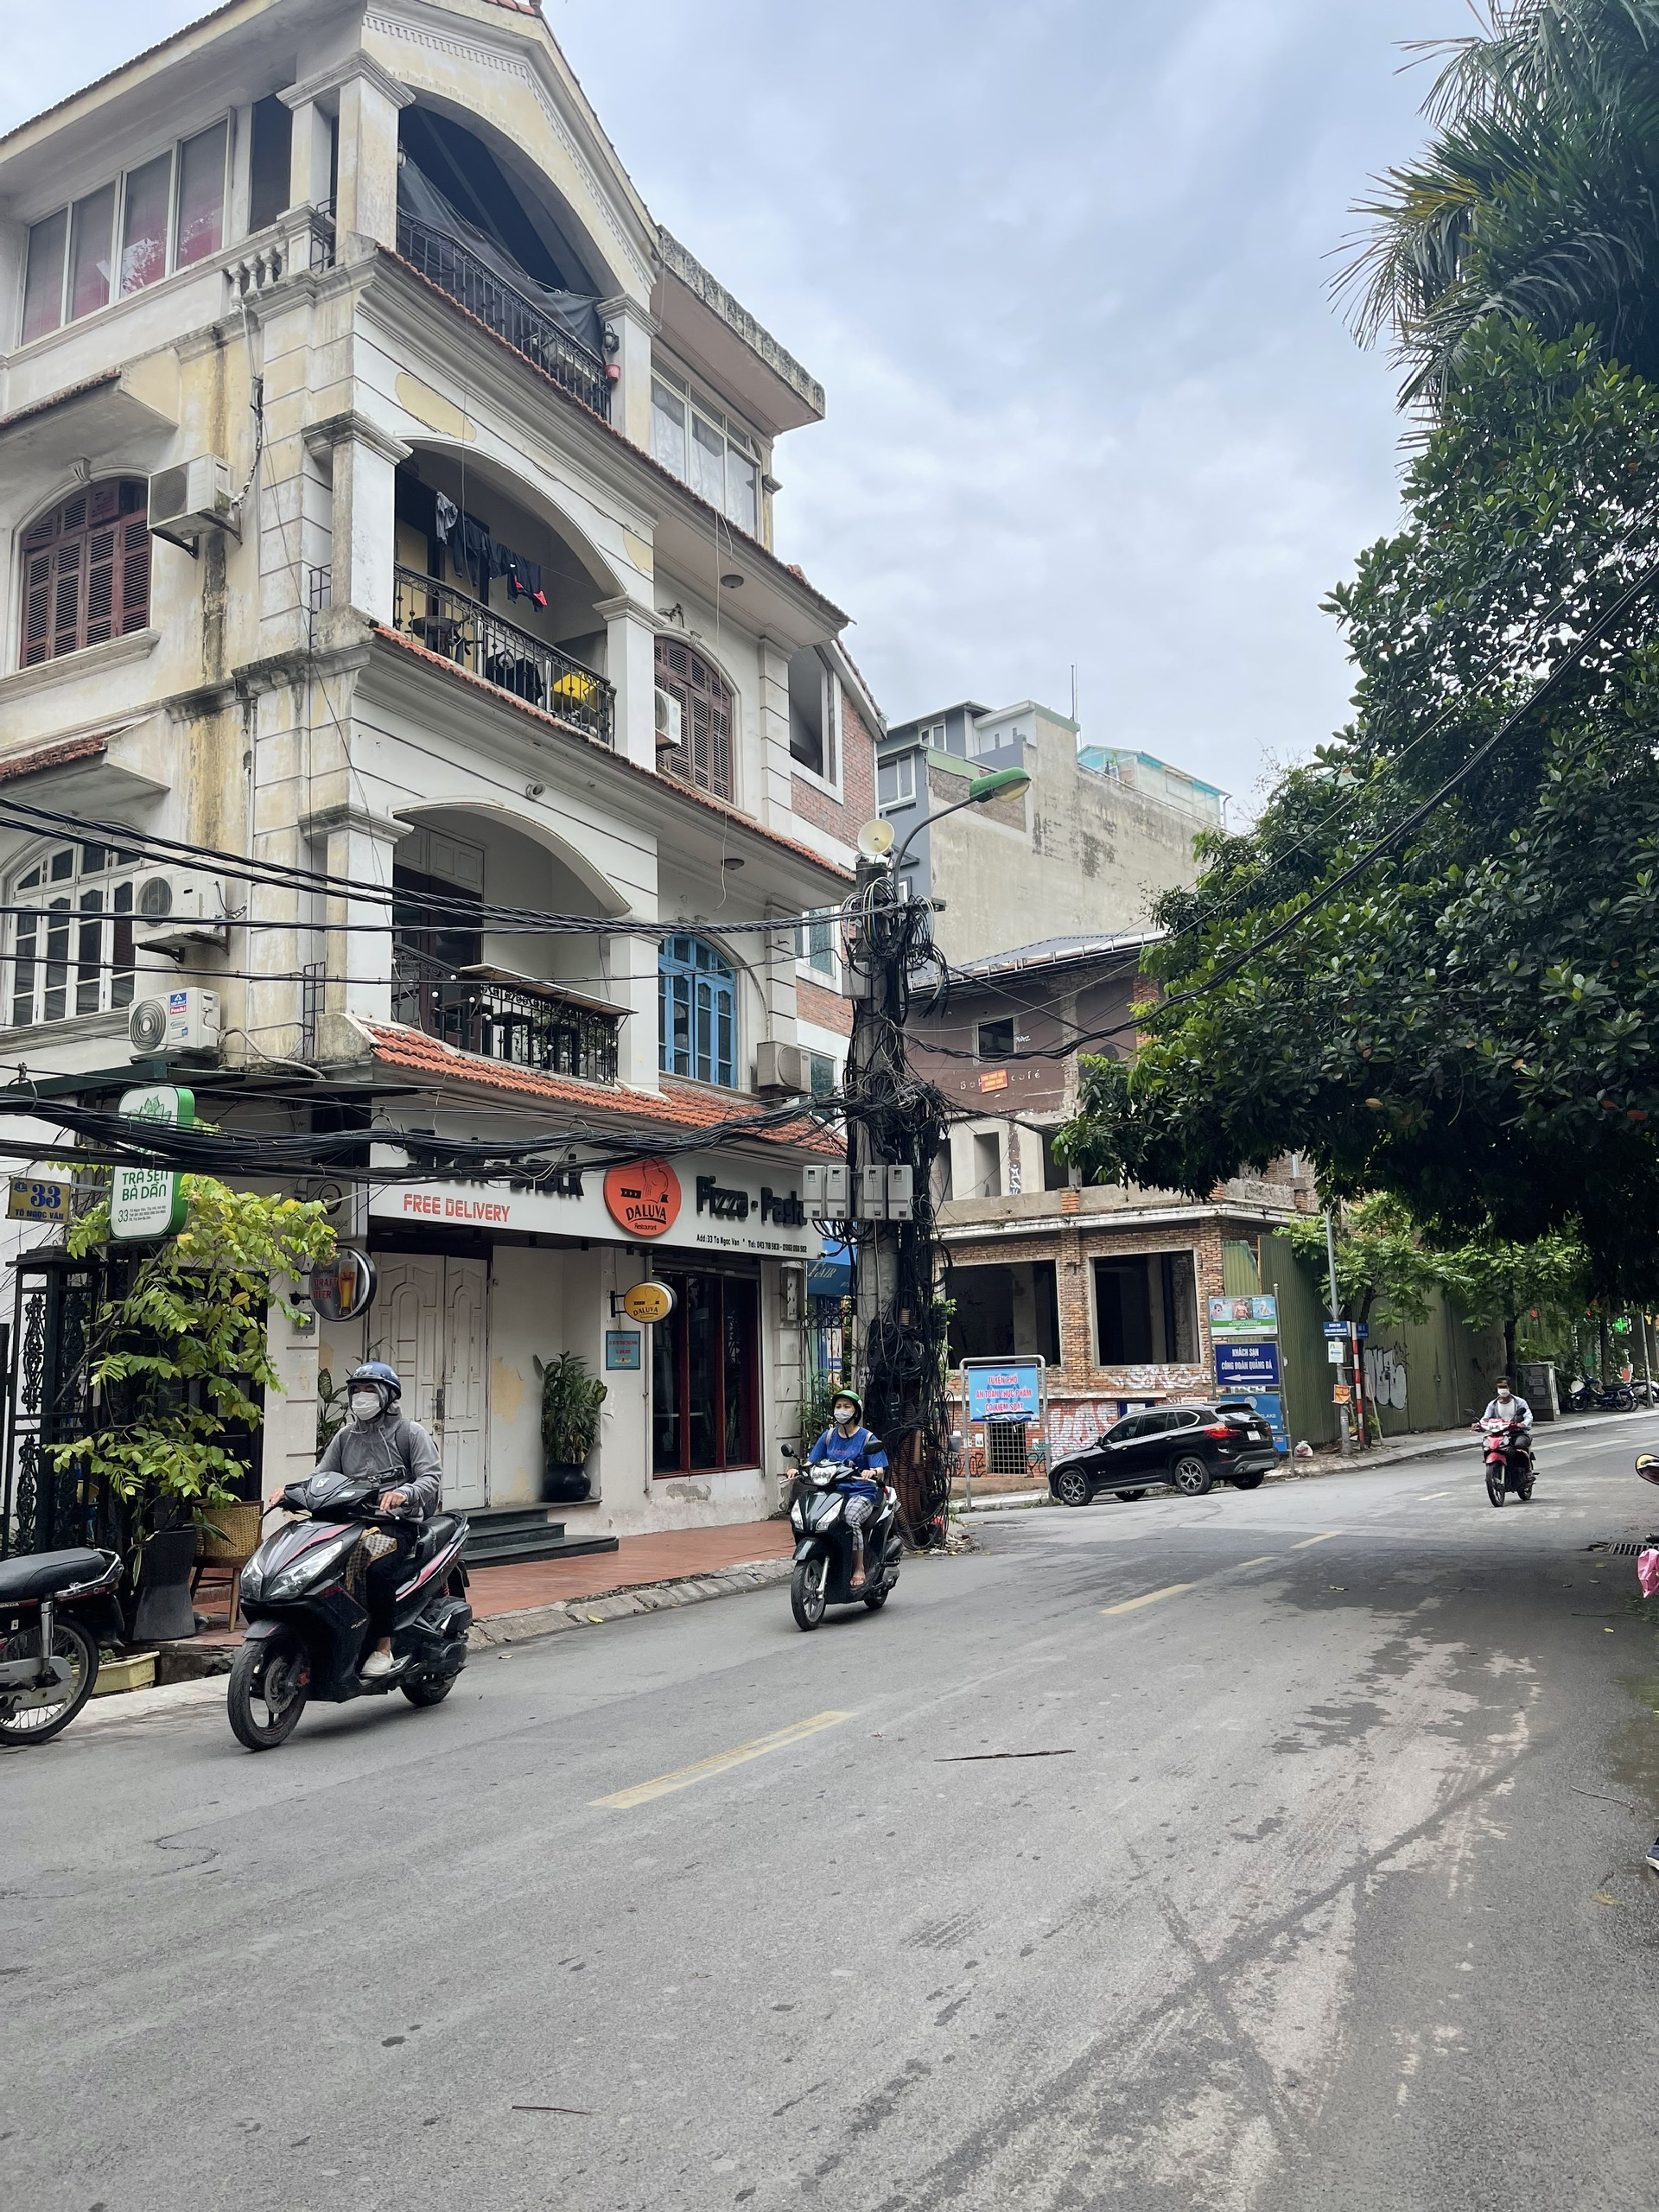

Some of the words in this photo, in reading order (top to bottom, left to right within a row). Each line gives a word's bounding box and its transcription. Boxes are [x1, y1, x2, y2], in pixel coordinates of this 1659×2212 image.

[122, 1168, 144, 1185] TRÀ
[30, 1184, 61, 1209] 33
[122, 1185, 138, 1201] BÀ
[141, 1182, 167, 1199] DẦN
[696, 1175, 749, 1217] Pizza
[118, 1209, 129, 1223] 33
[404, 1193, 441, 1215] FREE
[445, 1198, 511, 1222] DELIVERY
[626, 1204, 666, 1221] DALUVA
[313, 1290, 332, 1300] BEER
[632, 1306, 658, 1316] DALUVA
[1231, 1347, 1249, 1357] KHÁCH
[1249, 1348, 1260, 1358] SẠN
[976, 1389, 983, 1398] AN
